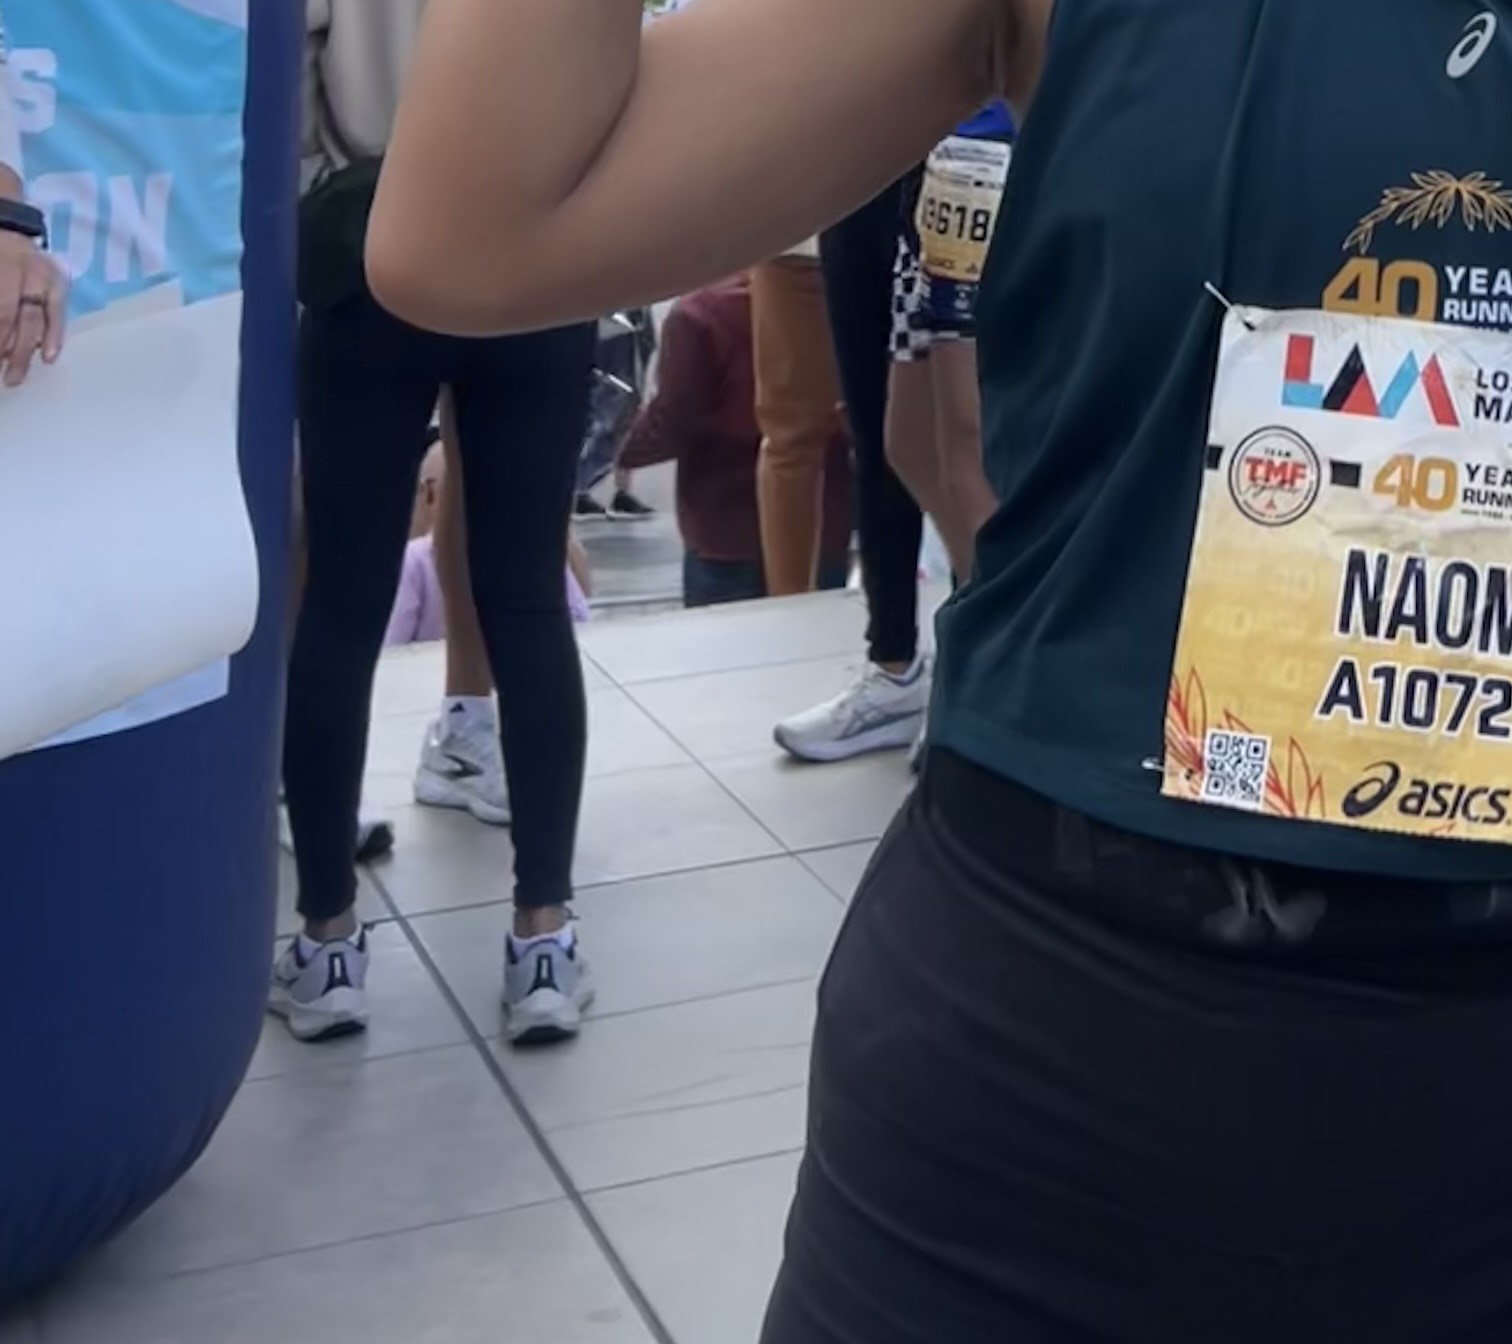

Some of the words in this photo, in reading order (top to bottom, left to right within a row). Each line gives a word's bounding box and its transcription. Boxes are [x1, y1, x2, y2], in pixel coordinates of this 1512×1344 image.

[1321, 256, 1438, 324] 40
[1245, 456, 1307, 488] TMF
[1372, 453, 1459, 513] 40
